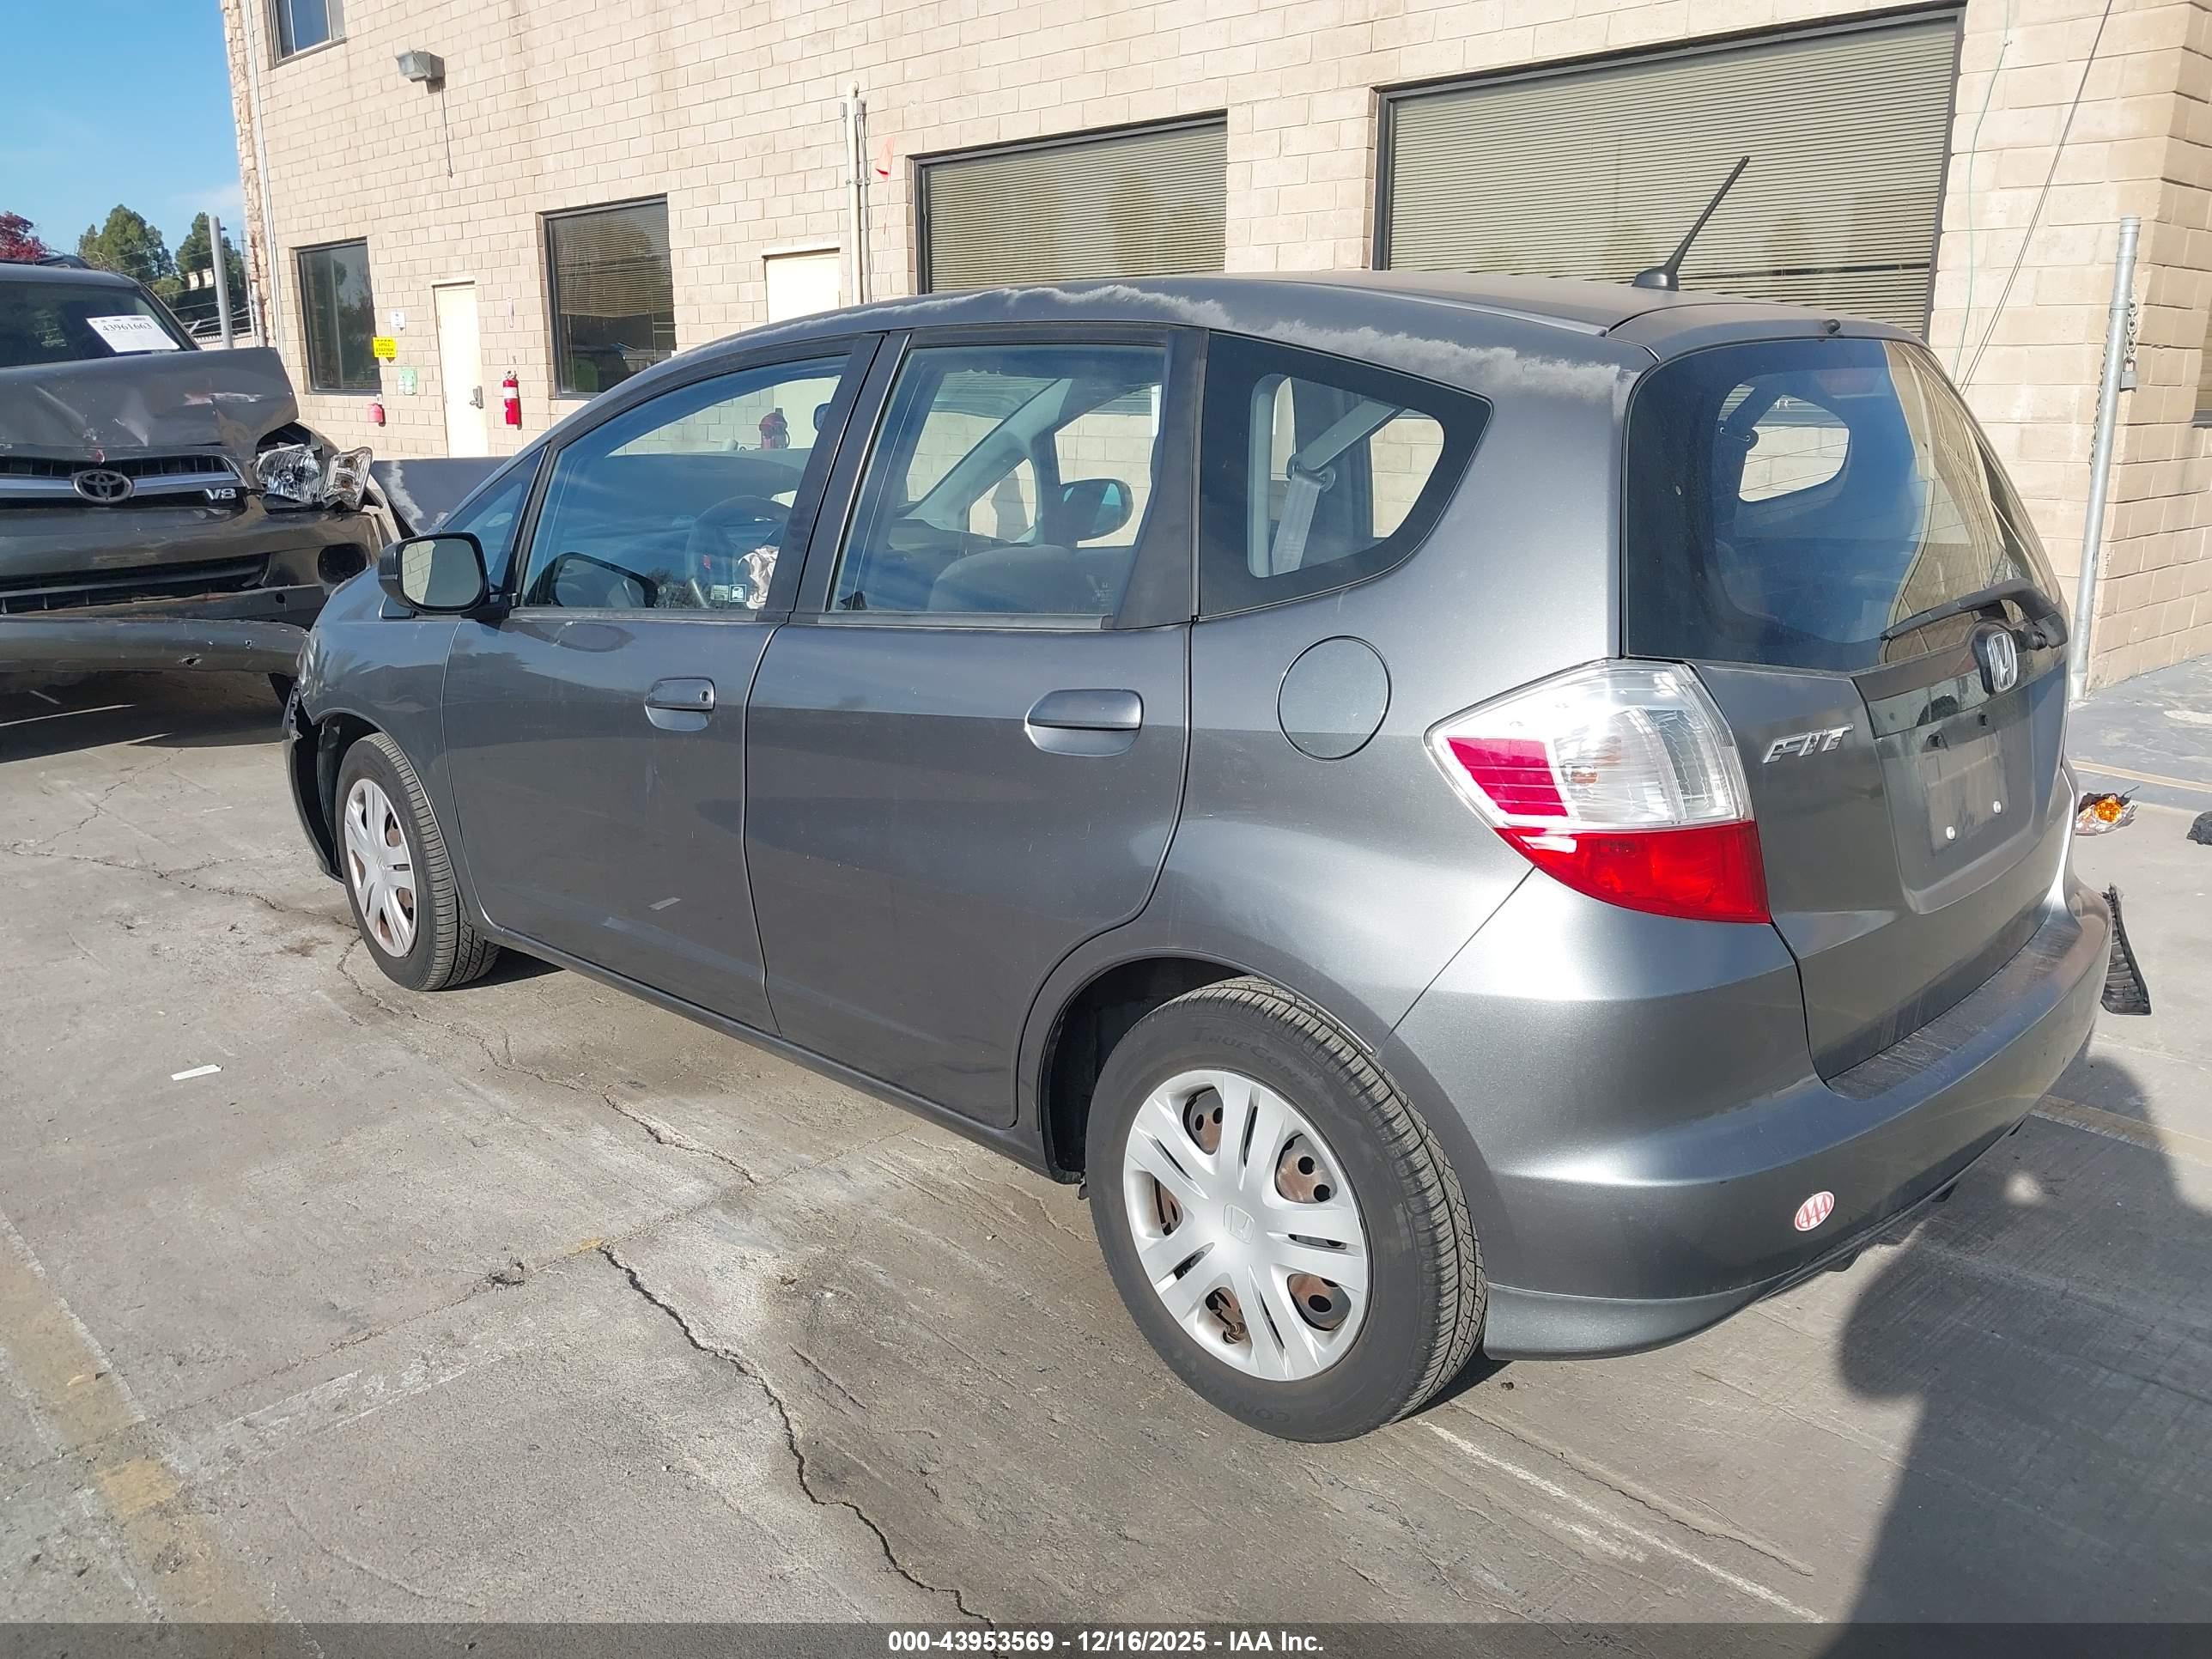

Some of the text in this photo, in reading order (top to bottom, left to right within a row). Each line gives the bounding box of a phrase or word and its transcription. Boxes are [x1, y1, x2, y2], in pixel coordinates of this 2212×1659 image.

[205, 488, 237, 500] V8
[1763, 723, 1855, 763] FIT
[1799, 1193, 1831, 1228] AAA
